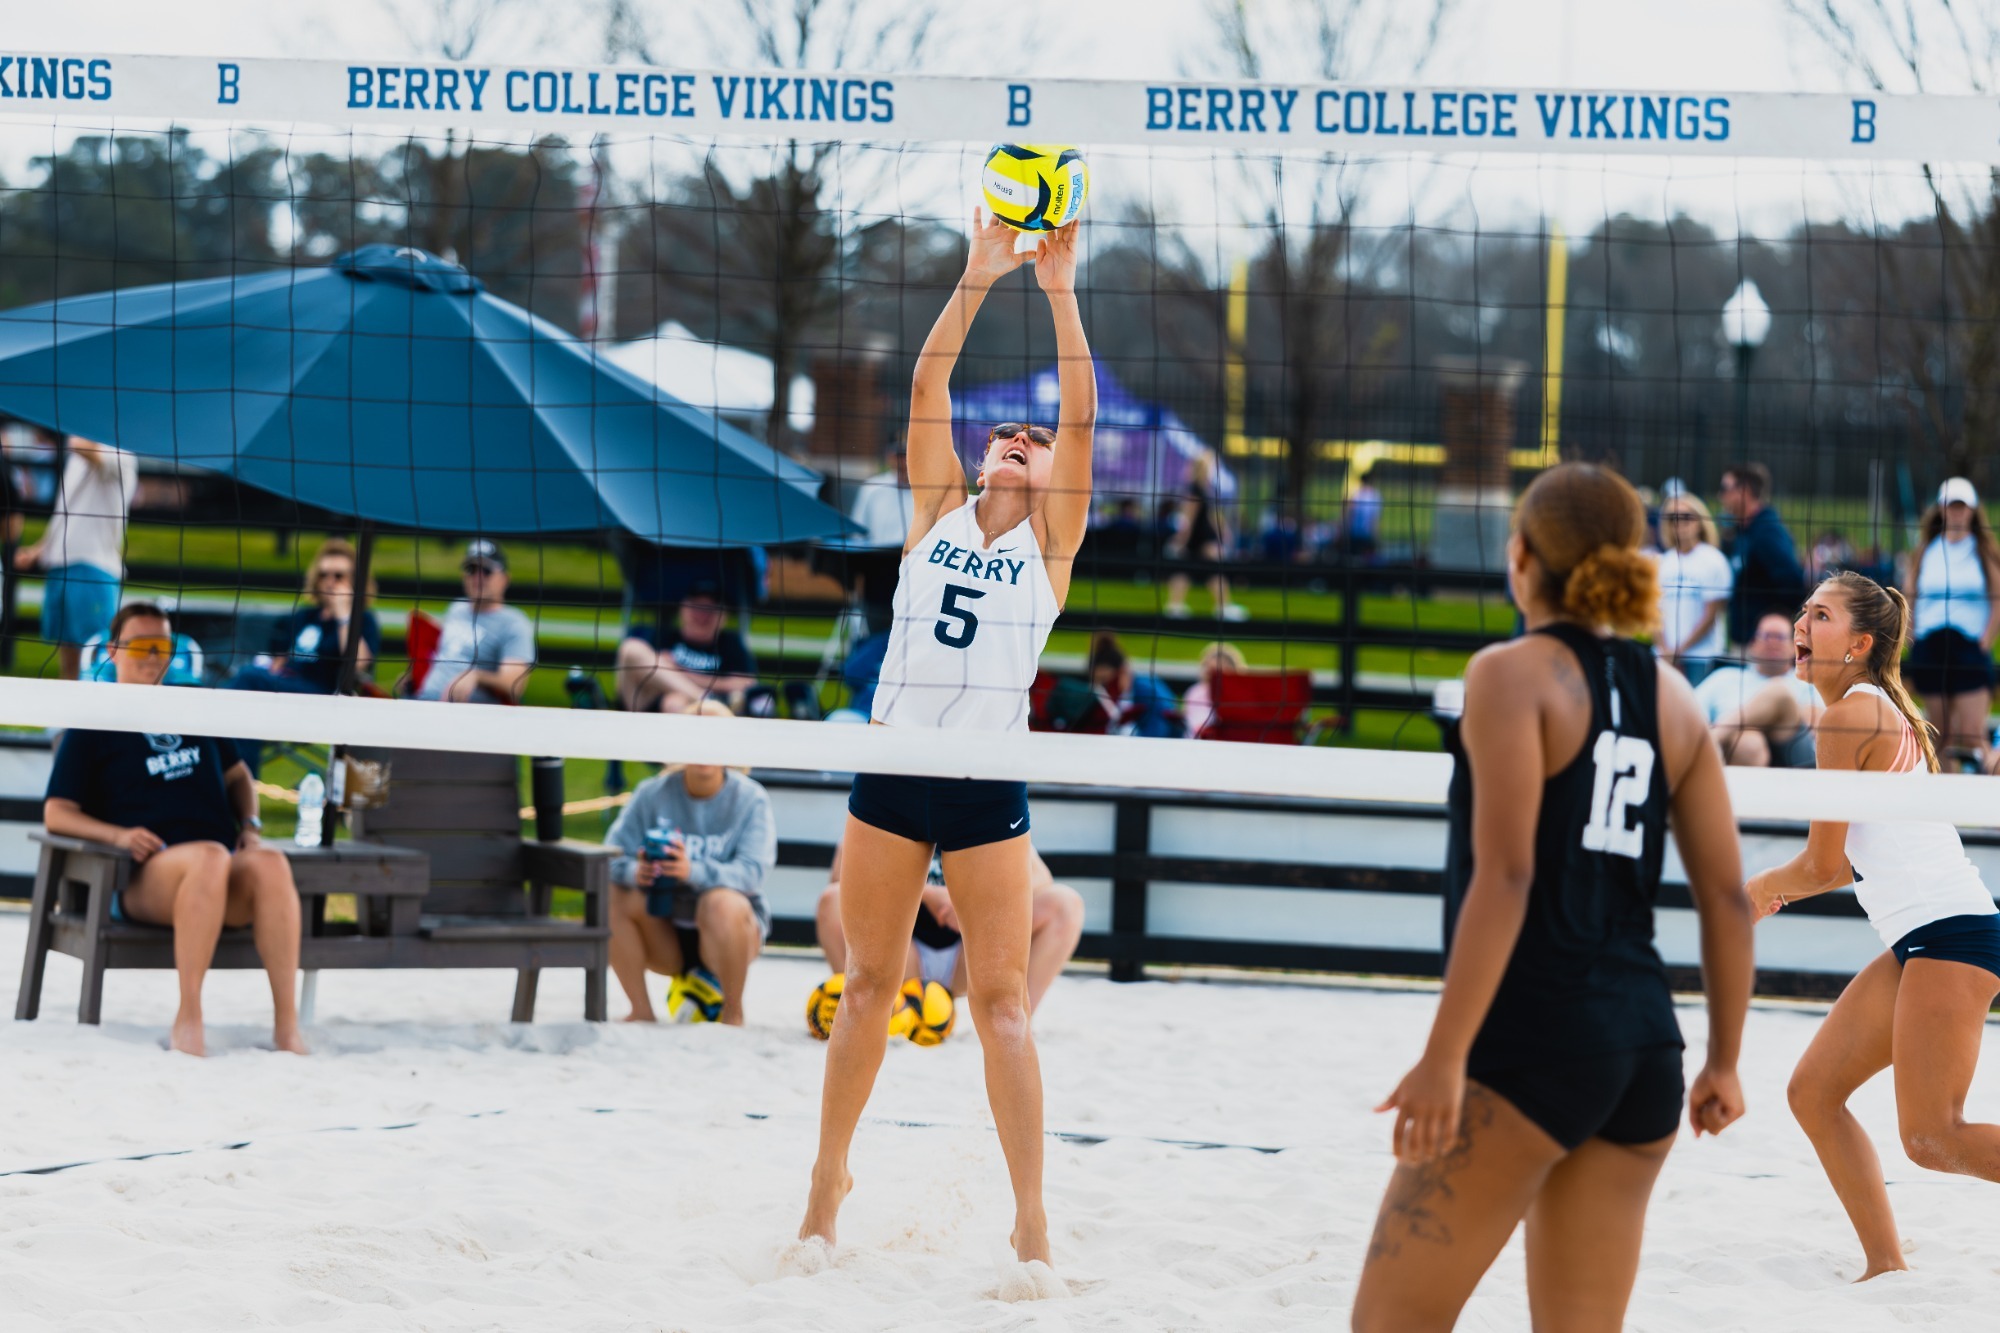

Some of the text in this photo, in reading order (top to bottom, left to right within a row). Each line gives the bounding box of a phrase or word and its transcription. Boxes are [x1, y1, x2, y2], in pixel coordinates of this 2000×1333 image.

[217, 64, 240, 105] B
[347, 66, 894, 124] BERRY COLLEGE VIKINGS
[1008, 84, 1031, 127] B
[1146, 87, 1730, 141] BERRY COLLEGE VIKINGS
[1851, 100, 1876, 144] B
[1053, 184, 1065, 215] molten
[1065, 172, 1084, 220] NCAA
[928, 539, 1025, 585] BERRY
[934, 583, 987, 649] 5
[1581, 730, 1655, 859] 12
